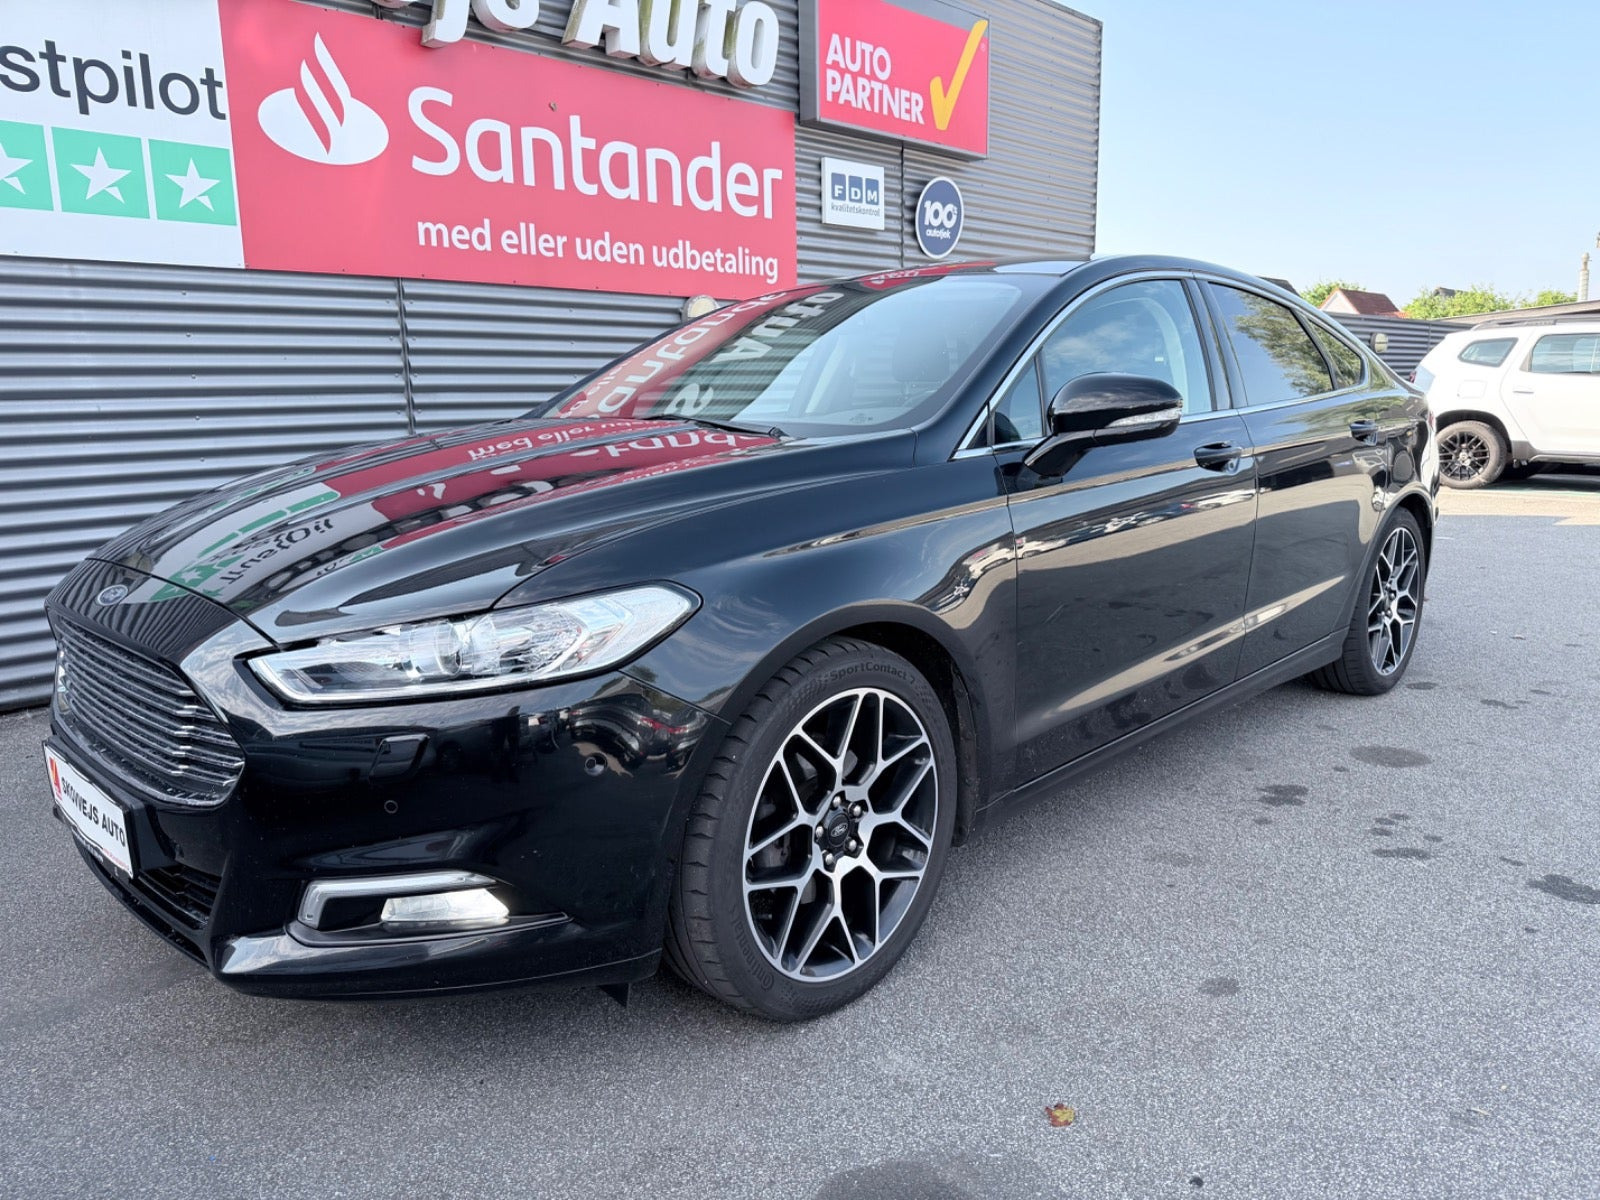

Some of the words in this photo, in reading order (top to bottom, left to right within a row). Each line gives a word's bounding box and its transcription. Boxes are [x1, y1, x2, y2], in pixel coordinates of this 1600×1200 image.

[826, 33, 892, 80] AUTO
[826, 68, 925, 125] PARTNER
[408, 86, 783, 219] Santander
[417, 218, 492, 252] med
[501, 222, 567, 258] eller
[575, 232, 645, 265] uden
[652, 240, 779, 284] udbetaling
[829, 661, 907, 681] SportContact
[101, 813, 126, 848] AUTO
